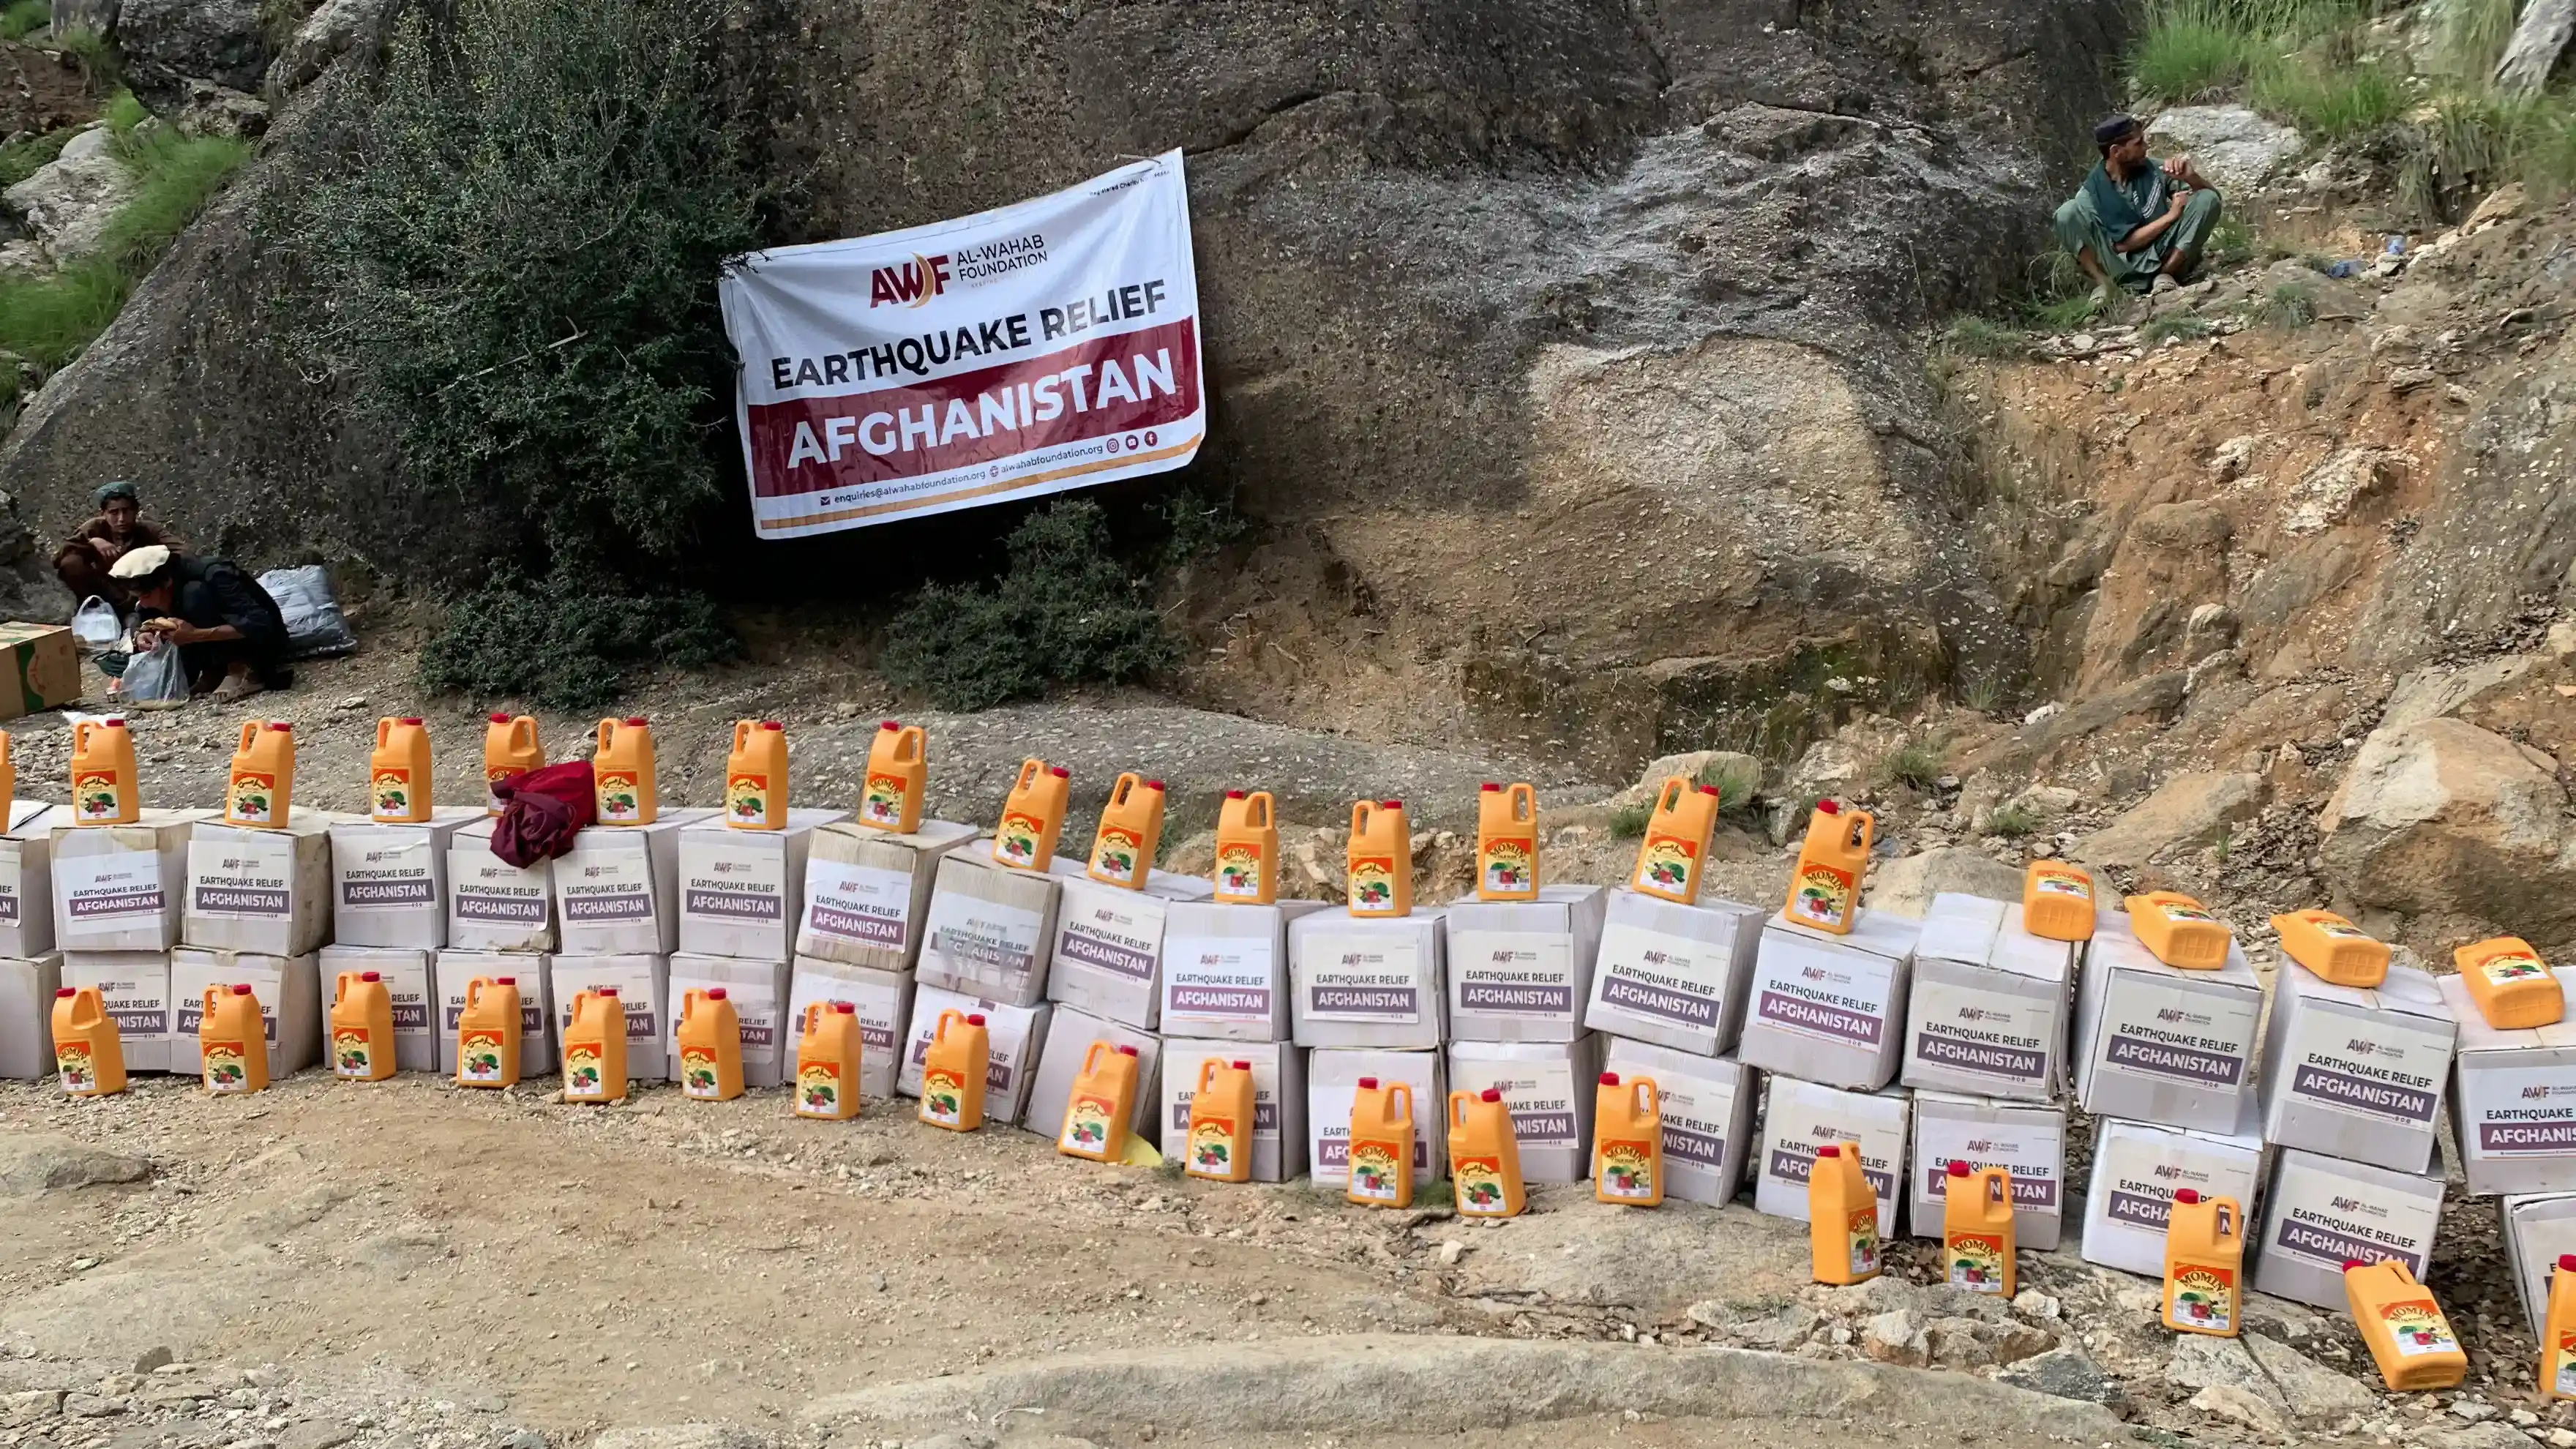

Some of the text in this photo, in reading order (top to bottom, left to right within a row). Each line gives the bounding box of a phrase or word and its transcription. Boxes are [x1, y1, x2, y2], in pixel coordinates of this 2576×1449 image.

[1120, 178, 1139, 189] Charity
[957, 234, 1044, 266] AL-WAHAB
[959, 251, 1047, 281] FOUNDATION
[870, 255, 951, 308] AWF
[771, 279, 1166, 390] EARTHQUAKE RELIEF
[787, 348, 1176, 469] AFGHANISTAN
[834, 444, 1104, 503] enquiries@alwahabfoundation.org alwahabfoundation.org
[1223, 850, 1254, 864] MOMIN
[1489, 843, 1527, 858] MOMIN
[200, 876, 284, 888] EARTHQUAKE RELIEF
[346, 869, 425, 880] EARTHQUAKE RELIEF
[1806, 872, 1845, 891] MOMIN
[73, 883, 158, 898] EARTHQUAKE RELIEF
[348, 884, 427, 899] AFGHANISTAN
[460, 884, 540, 897] EARTHQUAKE RELIEF
[566, 883, 643, 895] EARTHQUAKE RELIEF
[691, 879, 775, 892] EARTHQUAKE RELIEF
[76, 895, 159, 912] AFGHANISTAN
[201, 893, 283, 908] AFGHANISTAN
[461, 901, 540, 916] AFGHANISTAN
[571, 898, 645, 916] AFGHANISTAN
[692, 896, 774, 913] AFGHANISTAN
[816, 895, 900, 918] EARTHQUAKE RELIEF
[815, 911, 897, 939] AFGHANISTAN
[940, 925, 997, 946] EARTHQUAKE
[999, 940, 1030, 953] RELIEF
[1069, 921, 1152, 951] EARTHQUAKE RELIEF
[1066, 940, 1147, 973] AFGHANISTAN
[1176, 973, 1265, 986] EARTHQUAKE RELIEF
[1317, 974, 1409, 986] EARTHQUAKE RELIEF
[1466, 970, 1565, 984] EARTHQUAKE RELIEF
[1612, 964, 1715, 996] EARTHQUAKE RELIEF
[392, 994, 420, 1003] RELIEF
[1177, 990, 1263, 1008] AFGHANISTAN
[1318, 991, 1409, 1008] AFGHANISTAN
[1467, 989, 1563, 1006] AFGHANISTAN
[1609, 983, 1710, 1019] AFGHANISTAN
[1770, 979, 1877, 1013] EARTHQUAKE RELIEF
[103, 1000, 160, 1011] QUAKE RELIEF
[117, 1015, 160, 1029] NISTAN
[738, 1017, 768, 1027] RELIEF
[861, 1018, 889, 1028] RELIEF
[1767, 997, 1873, 1036] AFGHANISTAN
[1925, 1022, 2040, 1048] EARTHQUAKE RELIEF
[2120, 1023, 2239, 1053] EARTHQUAKE RELIEF
[1925, 1041, 2036, 1071] AFGHANISTAN
[2116, 1043, 2232, 1077] AFGHANISTAN
[2308, 1052, 2433, 1088] EARTHQUAKE RELIEF
[2303, 1074, 2425, 1113] AFGHANISTAN
[1535, 1100, 1566, 1111] RELIEF
[2487, 1108, 2574, 1120] EARTHQUAKE
[1685, 1119, 1720, 1134] RELIEF
[1812, 1125, 1837, 1139] AWF
[1662, 1134, 1715, 1158] NISTAN
[1780, 1139, 1888, 1169] EARTHQ ELIEF
[1967, 1139, 1992, 1153] AWF
[2012, 1164, 2049, 1177] RELIEF
[2155, 1164, 2181, 1180] AWF
[2119, 1179, 2174, 1200] EARTHQU
[2331, 1196, 2359, 1213] AWF
[2292, 1208, 2416, 1248] EARTHQUAKE RELIEF
[1954, 1240, 1997, 1257] MOMIN
[2180, 1272, 2226, 1292] MOMIN
[2389, 1306, 2435, 1320] MOMIN
